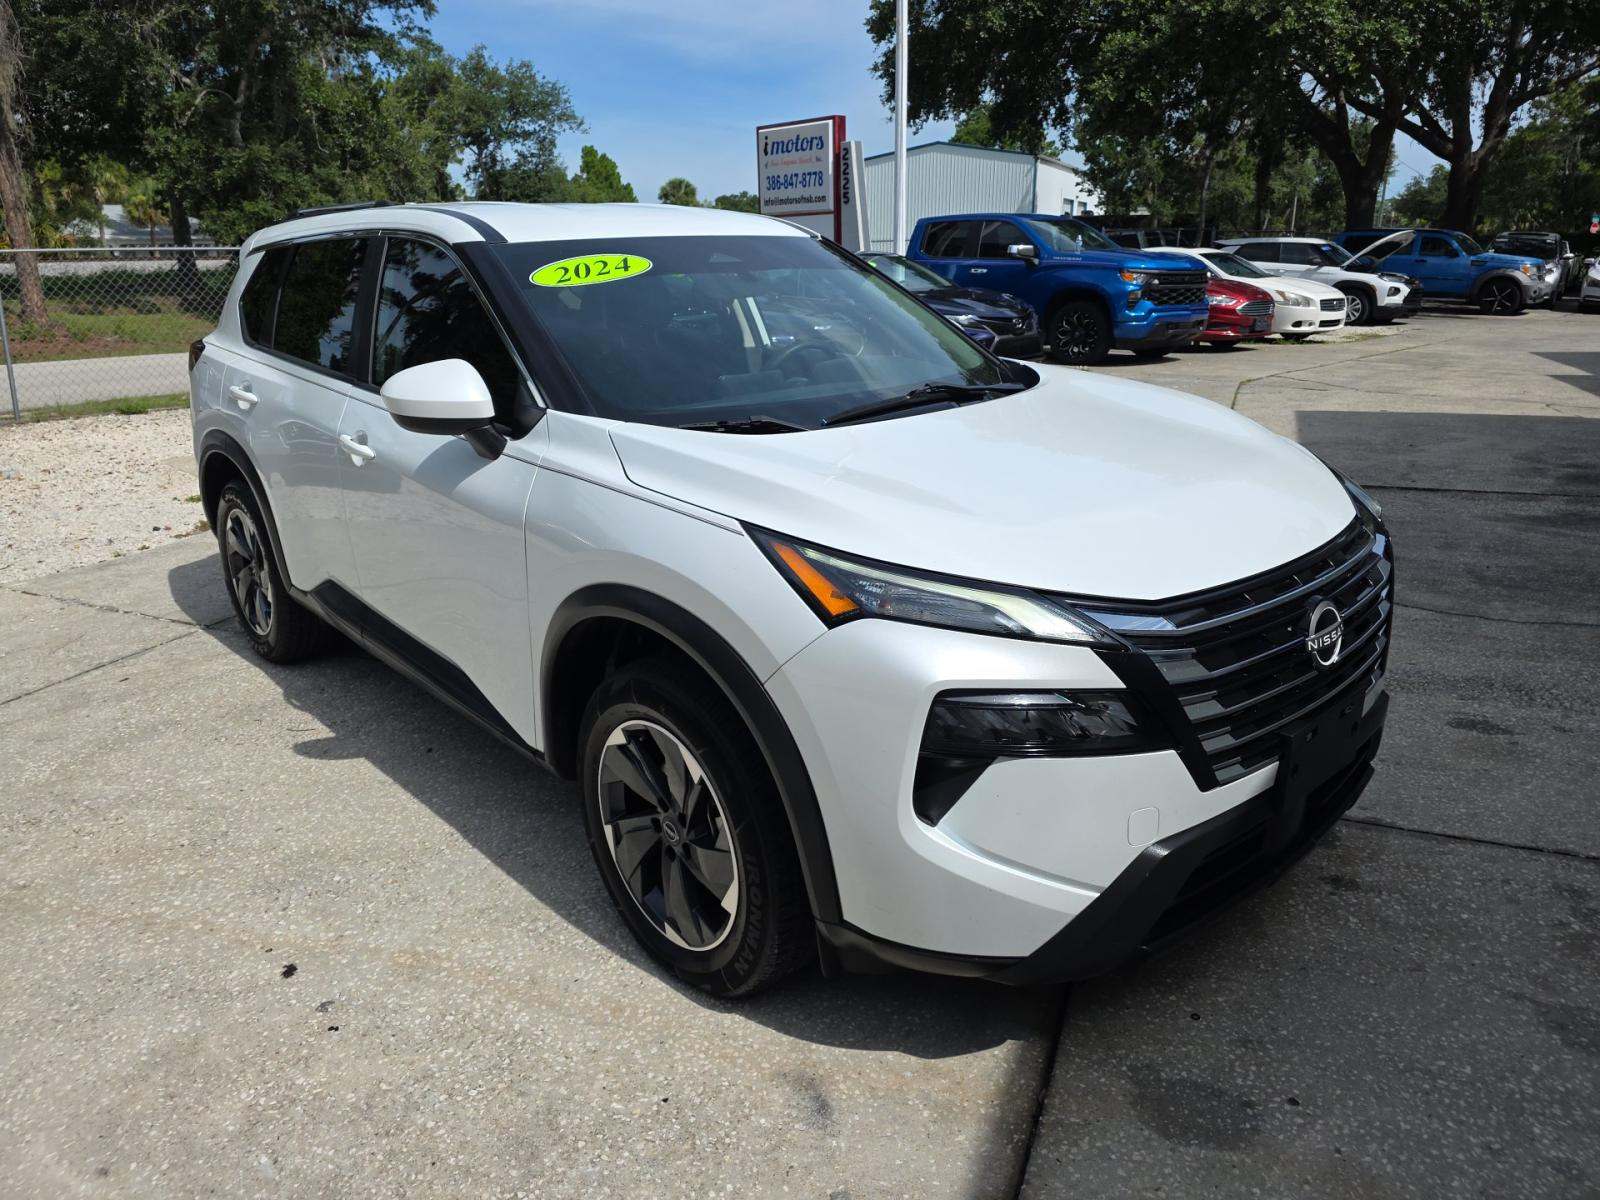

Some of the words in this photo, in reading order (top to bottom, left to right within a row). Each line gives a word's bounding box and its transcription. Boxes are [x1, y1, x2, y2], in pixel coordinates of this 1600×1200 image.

[766, 171, 824, 191] 386-847-8778
[842, 148, 850, 204] 2225
[554, 257, 631, 284] 2024
